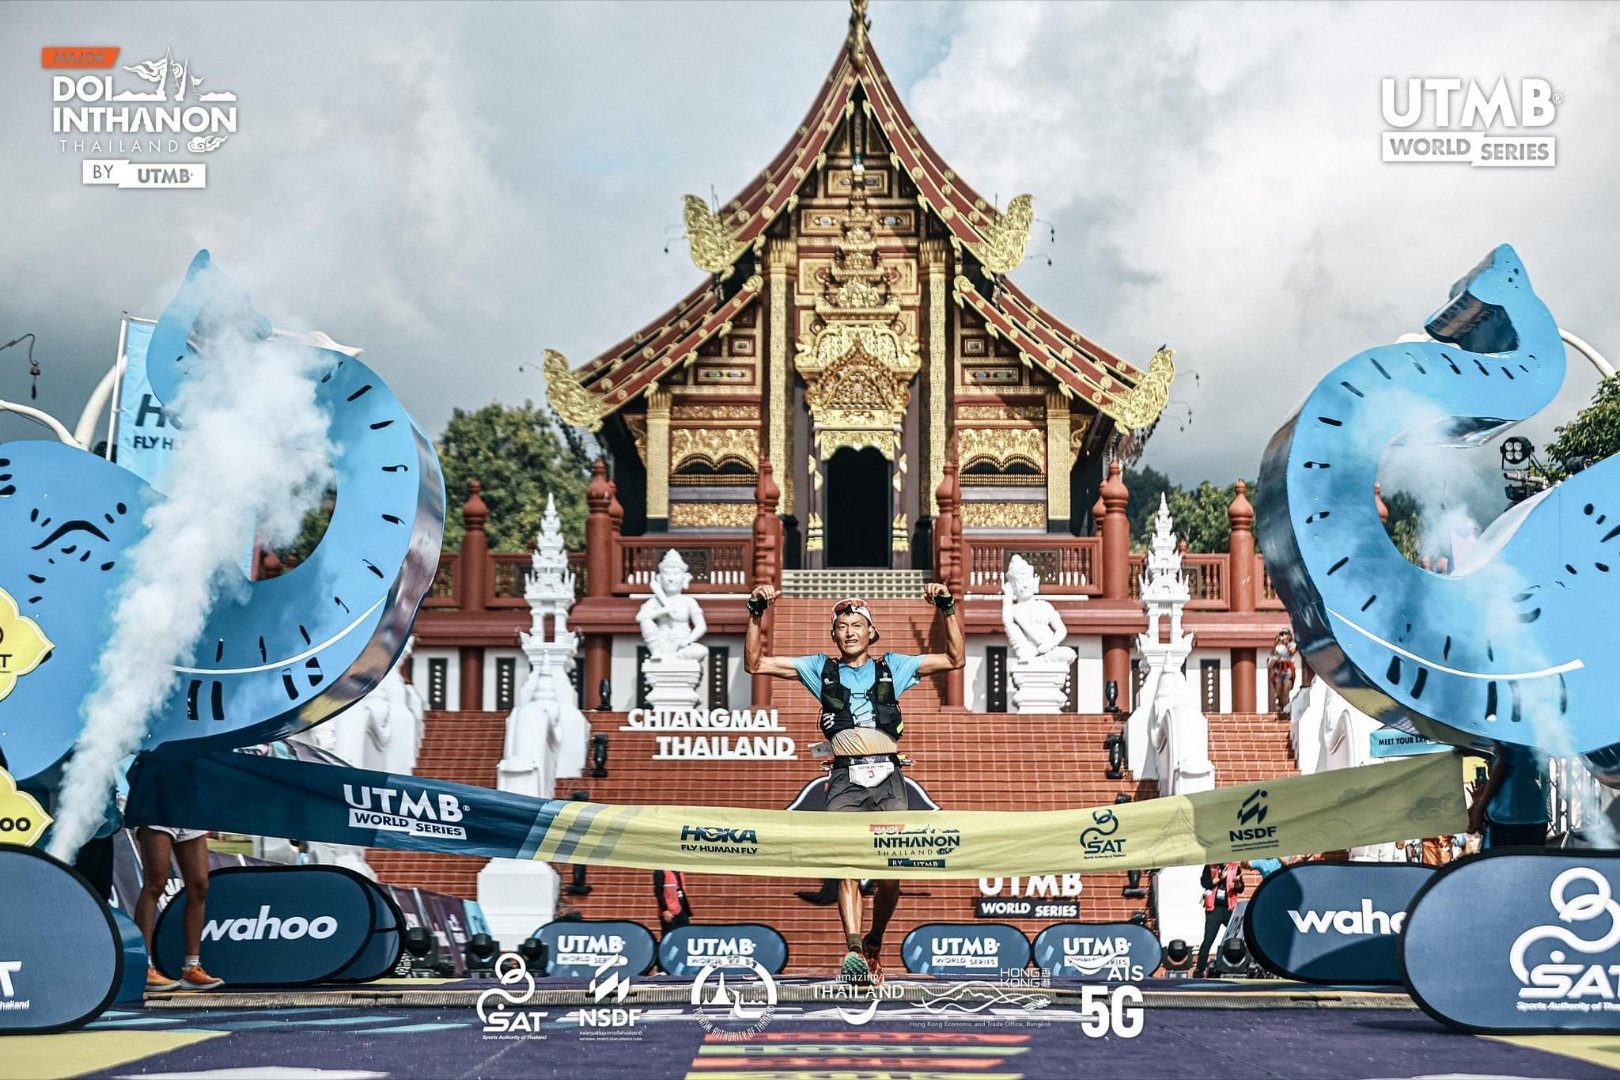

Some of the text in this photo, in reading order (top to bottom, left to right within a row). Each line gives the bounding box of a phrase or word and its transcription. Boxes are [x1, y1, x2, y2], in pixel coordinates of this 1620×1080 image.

[133, 435, 159, 450] FLY
[628, 708, 778, 728] CHIANGMAI
[655, 736, 796, 757] THAILAND
[1378, 738, 1394, 746] MEET
[1395, 736, 1414, 745] YOUR
[354, 811, 462, 837] WORLD SERIES
[681, 825, 758, 844] HOKA
[1229, 826, 1277, 842] NSDF
[681, 844, 758, 855] FLY HUMAN FLY
[873, 836, 960, 849] INTHANON
[1084, 838, 1127, 854] SAT
[877, 849, 933, 857] THAILAND
[981, 902, 1078, 918] WORLD SERIES
[1516, 1001, 1547, 1013] Sports
[1547, 1001, 1590, 1013] Authority
